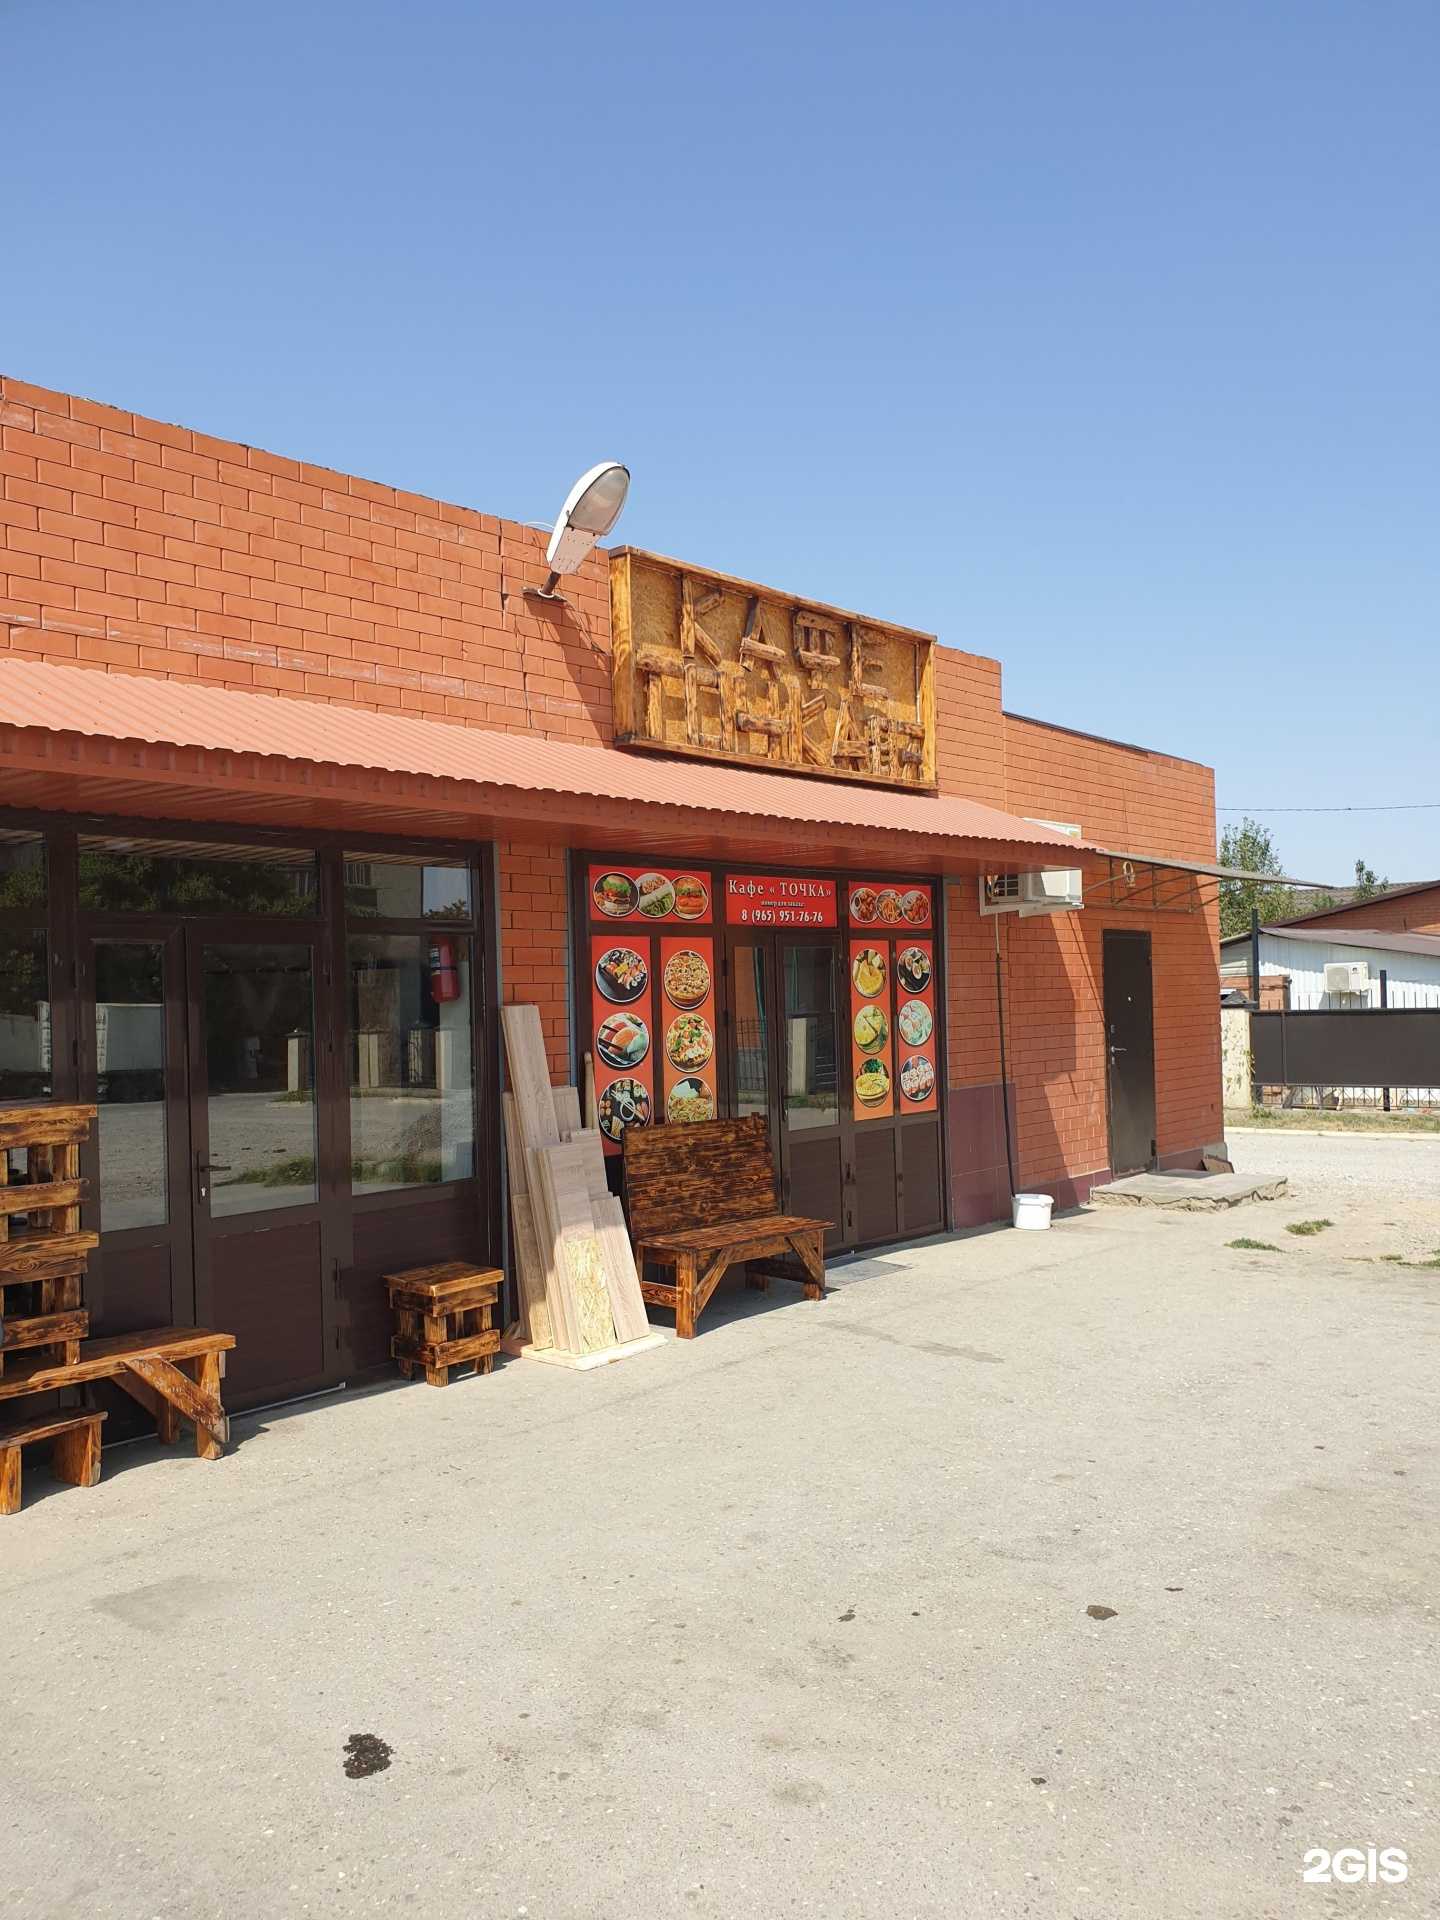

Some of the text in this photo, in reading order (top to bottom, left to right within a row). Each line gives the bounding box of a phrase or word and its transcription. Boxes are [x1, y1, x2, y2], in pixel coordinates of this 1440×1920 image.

[729, 879, 764, 897] Кафе
[741, 908, 823, 923] 8 (965) 951-76-76
